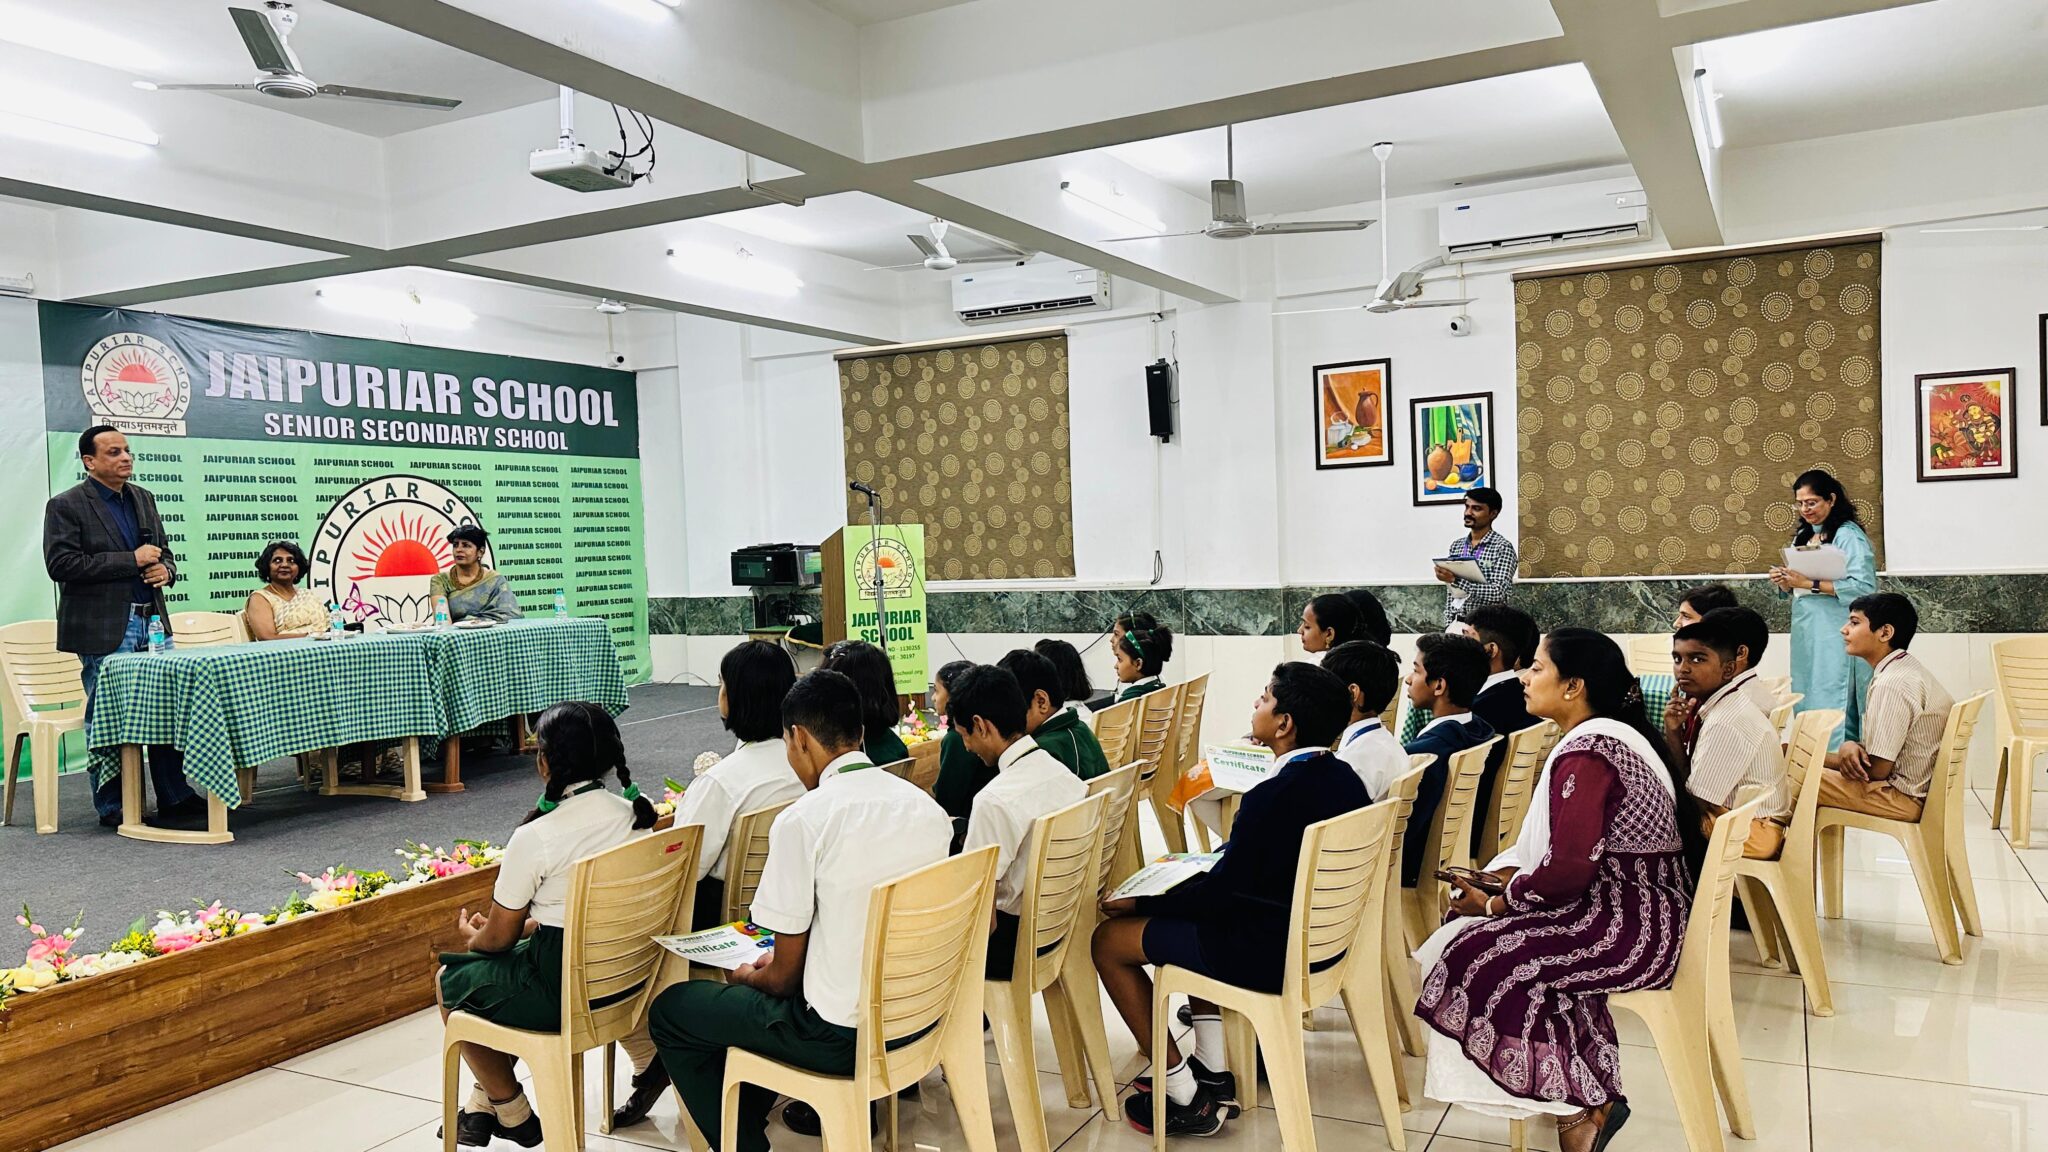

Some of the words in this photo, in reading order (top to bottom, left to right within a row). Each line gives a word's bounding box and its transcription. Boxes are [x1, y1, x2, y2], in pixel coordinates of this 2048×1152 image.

[204, 350, 462, 415] JAIPURIAR
[471, 376, 619, 428] SCHOOL
[264, 412, 356, 440] SENIOR
[362, 419, 489, 446] SECONDARY
[494, 427, 568, 451] SCHOOL
[138, 453, 182, 462] SCHOOL
[203, 455, 256, 464] JAIPURIAR
[258, 457, 296, 465] SCHOOL
[314, 459, 359, 467] JAIPURIAR
[361, 460, 394, 468] SCHOOL
[410, 461, 450, 469] JAIPURIAR
[139, 473, 184, 482] SCHOOL
[204, 475, 256, 483] JAIPURIAR
[259, 476, 297, 484] SCHOOL
[453, 479, 482, 487] SCHOOL
[154, 494, 184, 502] HOOL
[205, 494, 257, 502] JAIPURIAR
[206, 513, 258, 521] JAIPURIAR
[207, 533, 259, 541] JAIPURIAR
[577, 599, 609, 607] JAIPURIAR
[611, 611, 634, 619] SCHOOL
[1213, 757, 1266, 773] Certificate
[676, 941, 738, 953] Certificate
